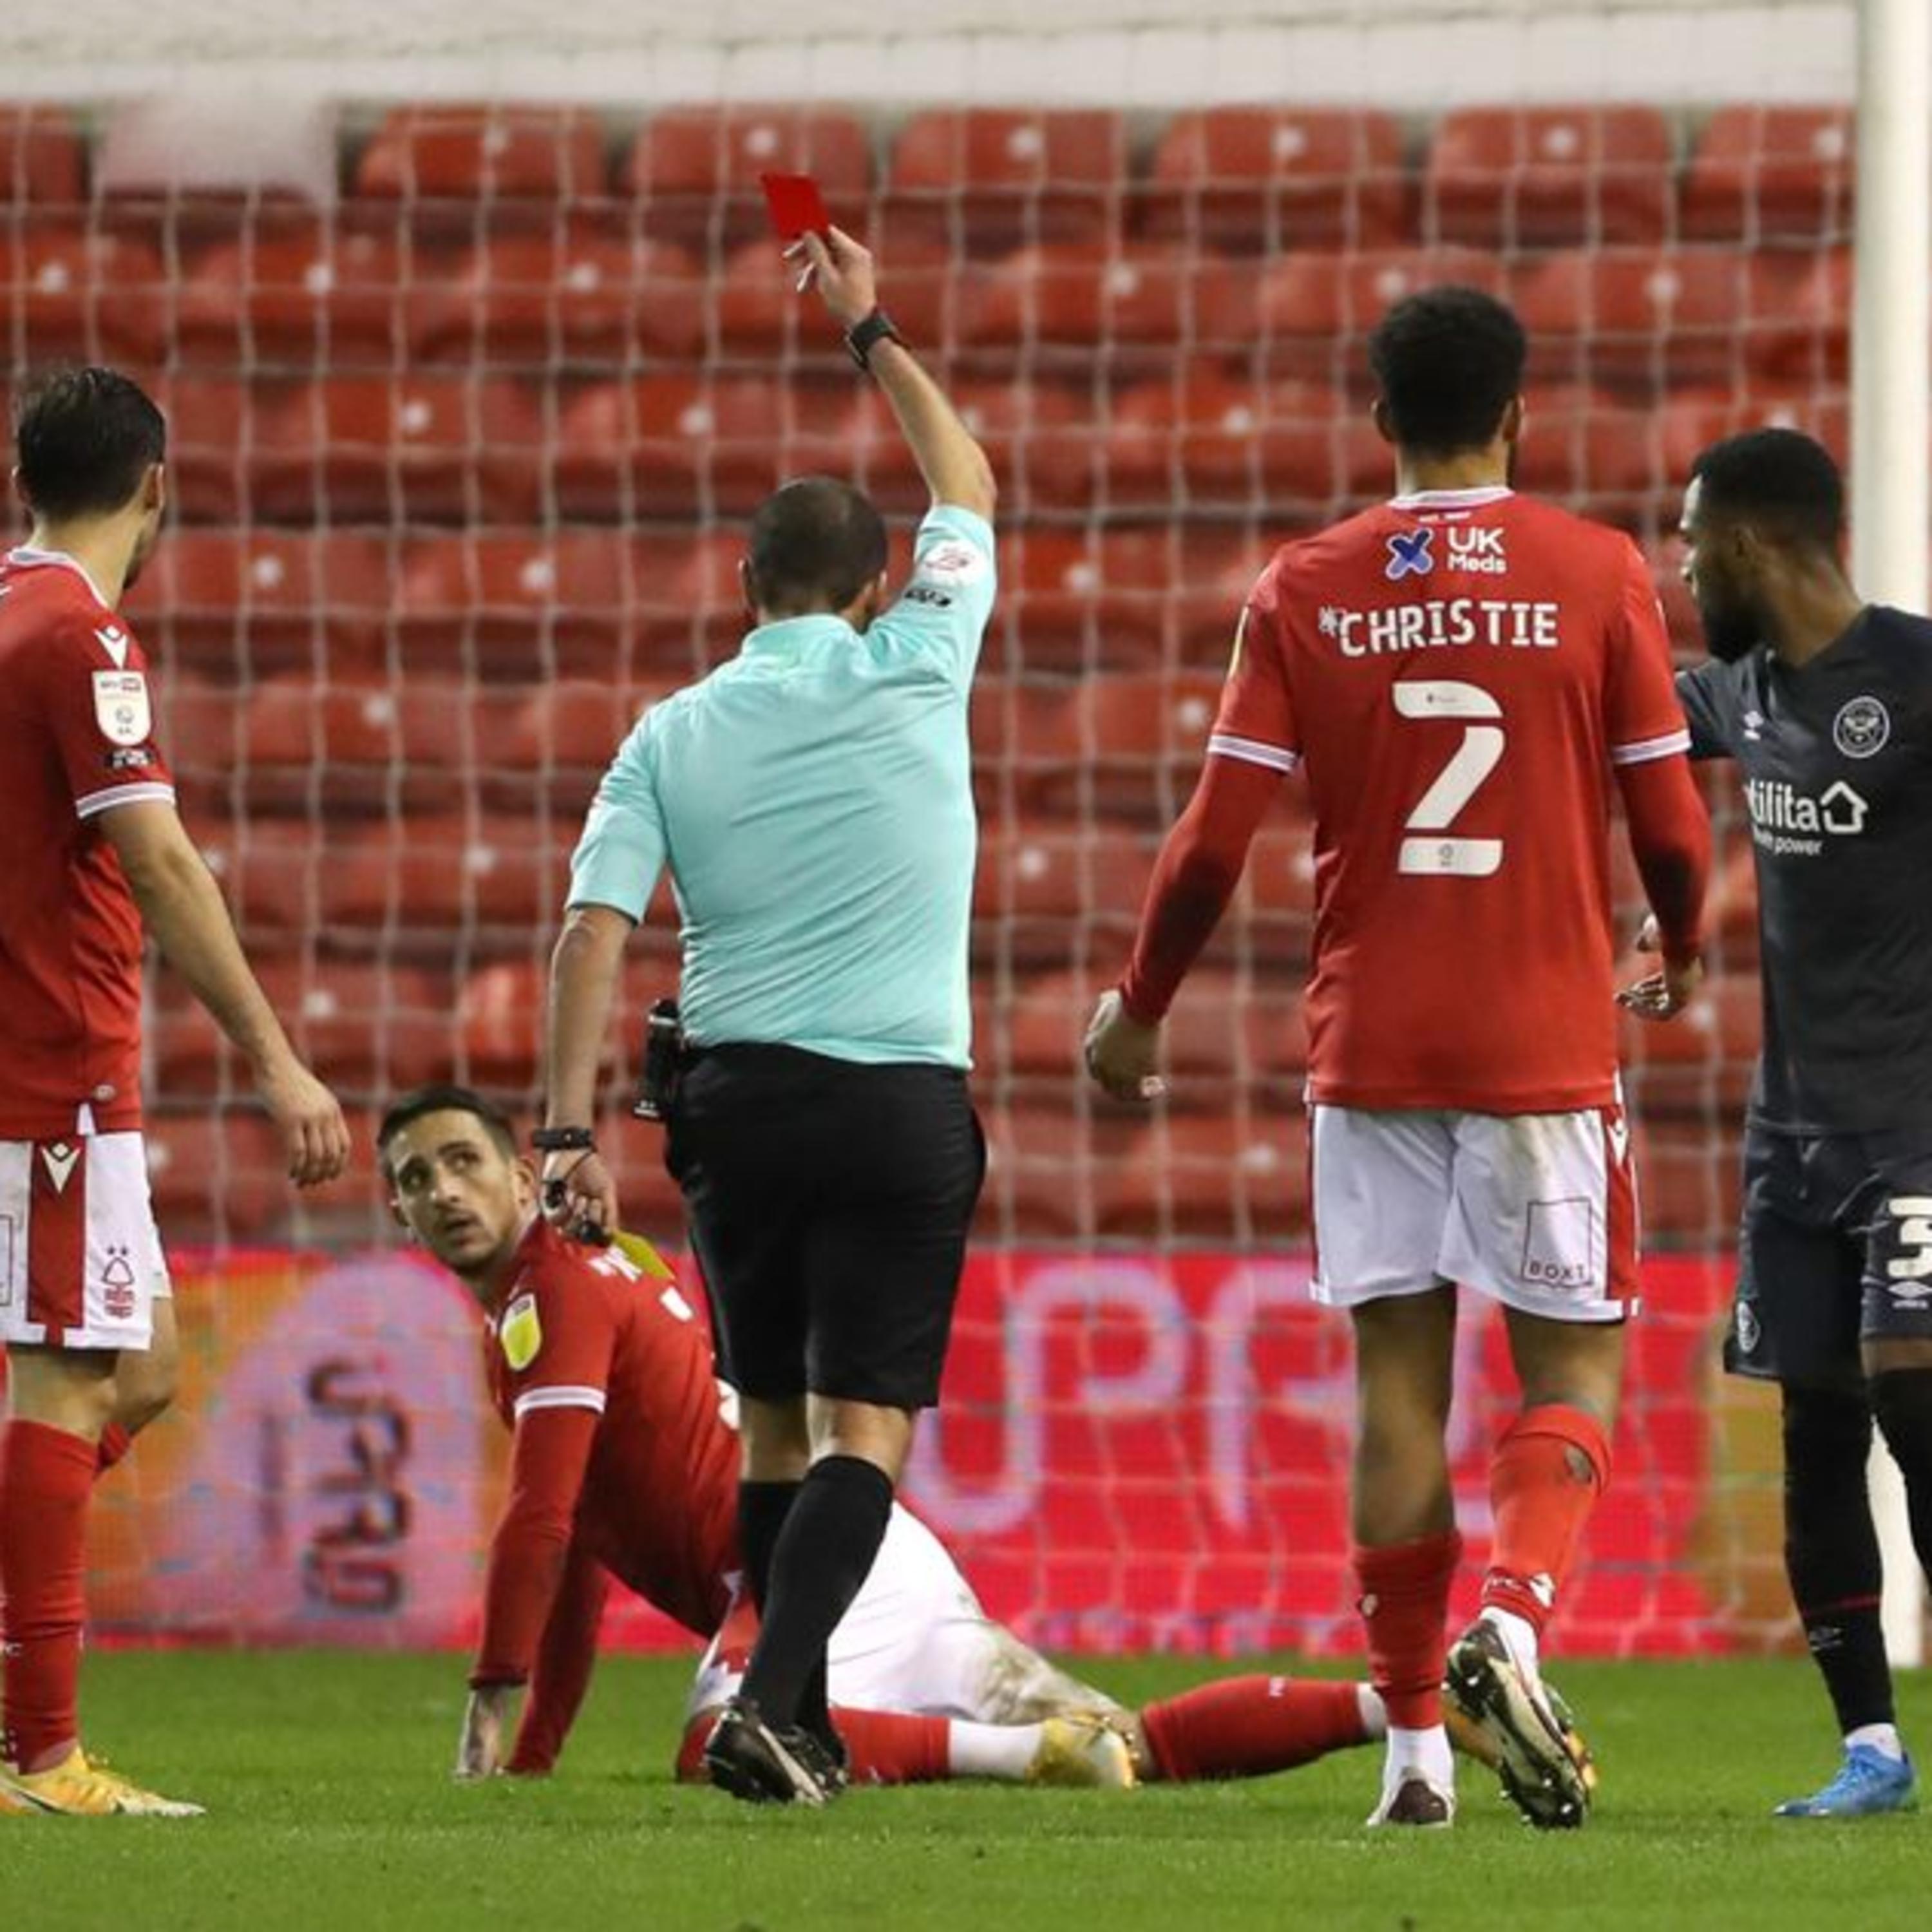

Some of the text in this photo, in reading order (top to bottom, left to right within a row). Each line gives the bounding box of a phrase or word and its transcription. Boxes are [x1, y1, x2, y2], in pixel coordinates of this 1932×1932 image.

[1447, 526, 1505, 554] UK
[1447, 553, 1508, 574] Meds
[1339, 598, 1558, 657] CHRISTIE
[1392, 680, 1506, 875] 2
[1743, 777, 1821, 833] tilita
[1774, 836, 1824, 856] power
